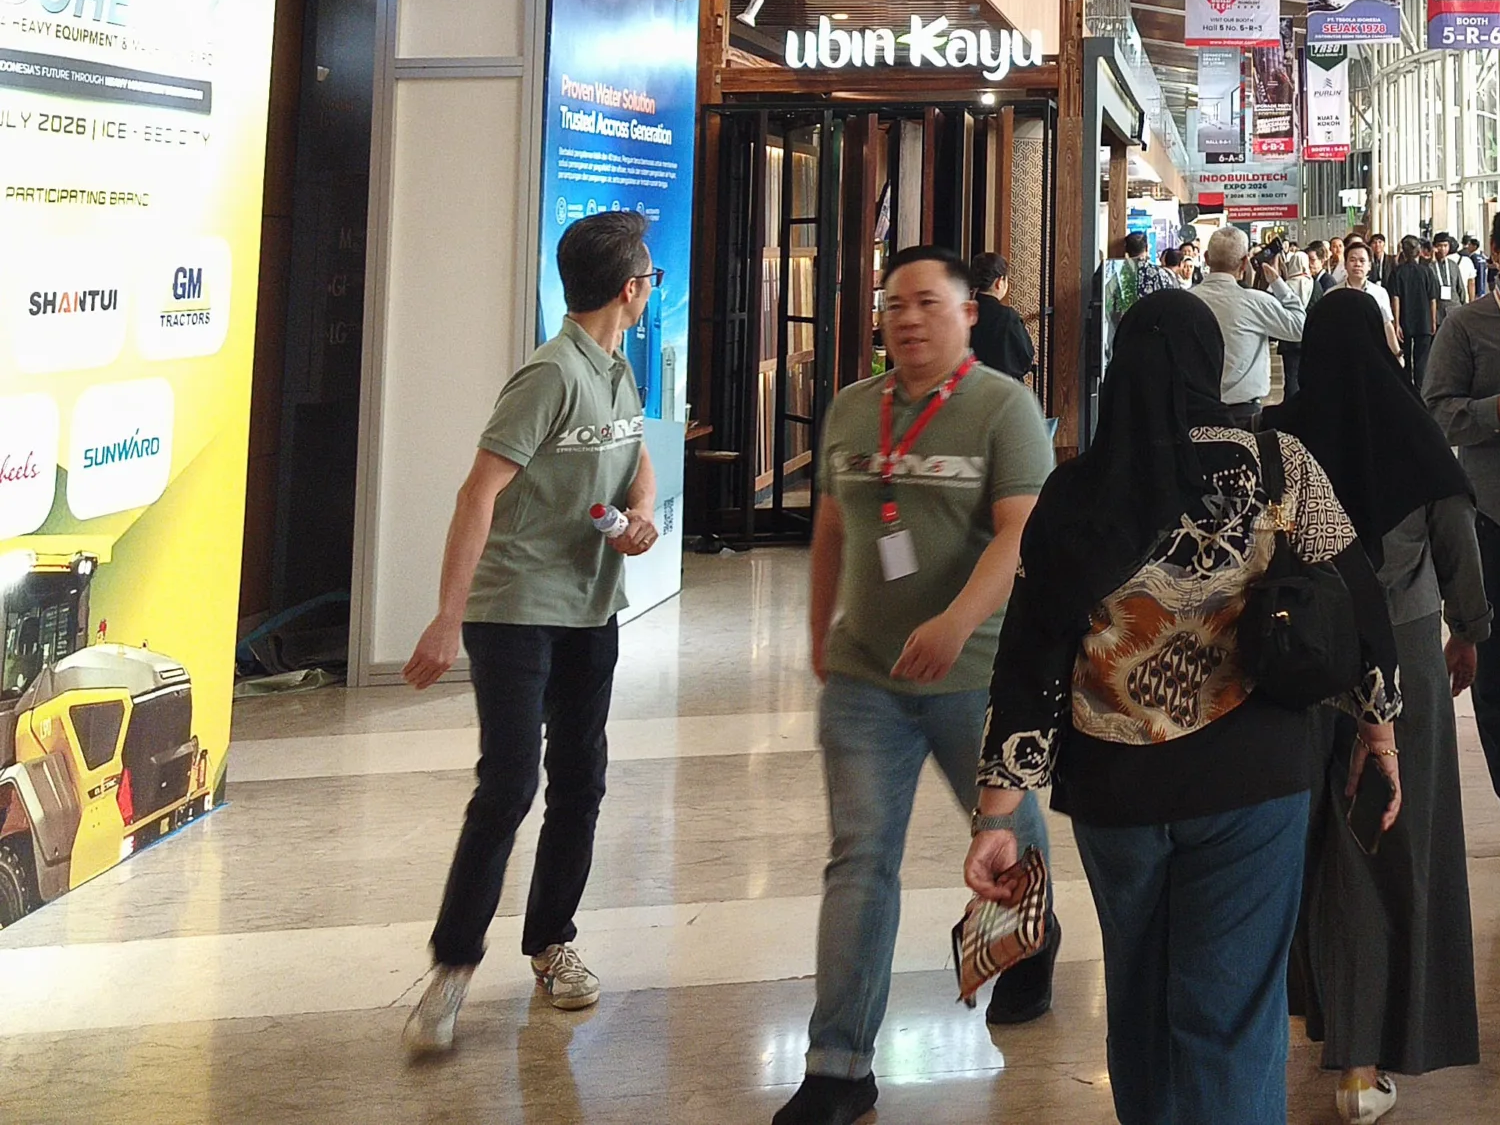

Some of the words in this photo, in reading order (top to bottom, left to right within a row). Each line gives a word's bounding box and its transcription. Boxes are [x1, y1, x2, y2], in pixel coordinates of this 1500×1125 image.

[1323, 24, 1359, 33] SEJAK
[1362, 24, 1386, 33] 1978
[1456, 17, 1488, 25] BOOTH
[56, 24, 118, 47] EQUIPMENT
[785, 15, 895, 68] ubin
[909, 14, 1042, 81] Kayu
[71, 71, 104, 85] THROUGH
[562, 75, 594, 101] Proven
[596, 83, 622, 108] Water
[622, 90, 656, 115] Solution
[38, 113, 86, 135] 2026
[560, 106, 597, 134] Trusted
[631, 119, 673, 146] Generation
[1200, 173, 1288, 183] INDOBUILDTECH
[6, 187, 106, 205] PARTICIPATING
[172, 267, 202, 300] GM
[29, 289, 118, 316] SHANTUI
[160, 312, 211, 327] TRACTORS
[84, 428, 159, 469] SUNWARD
